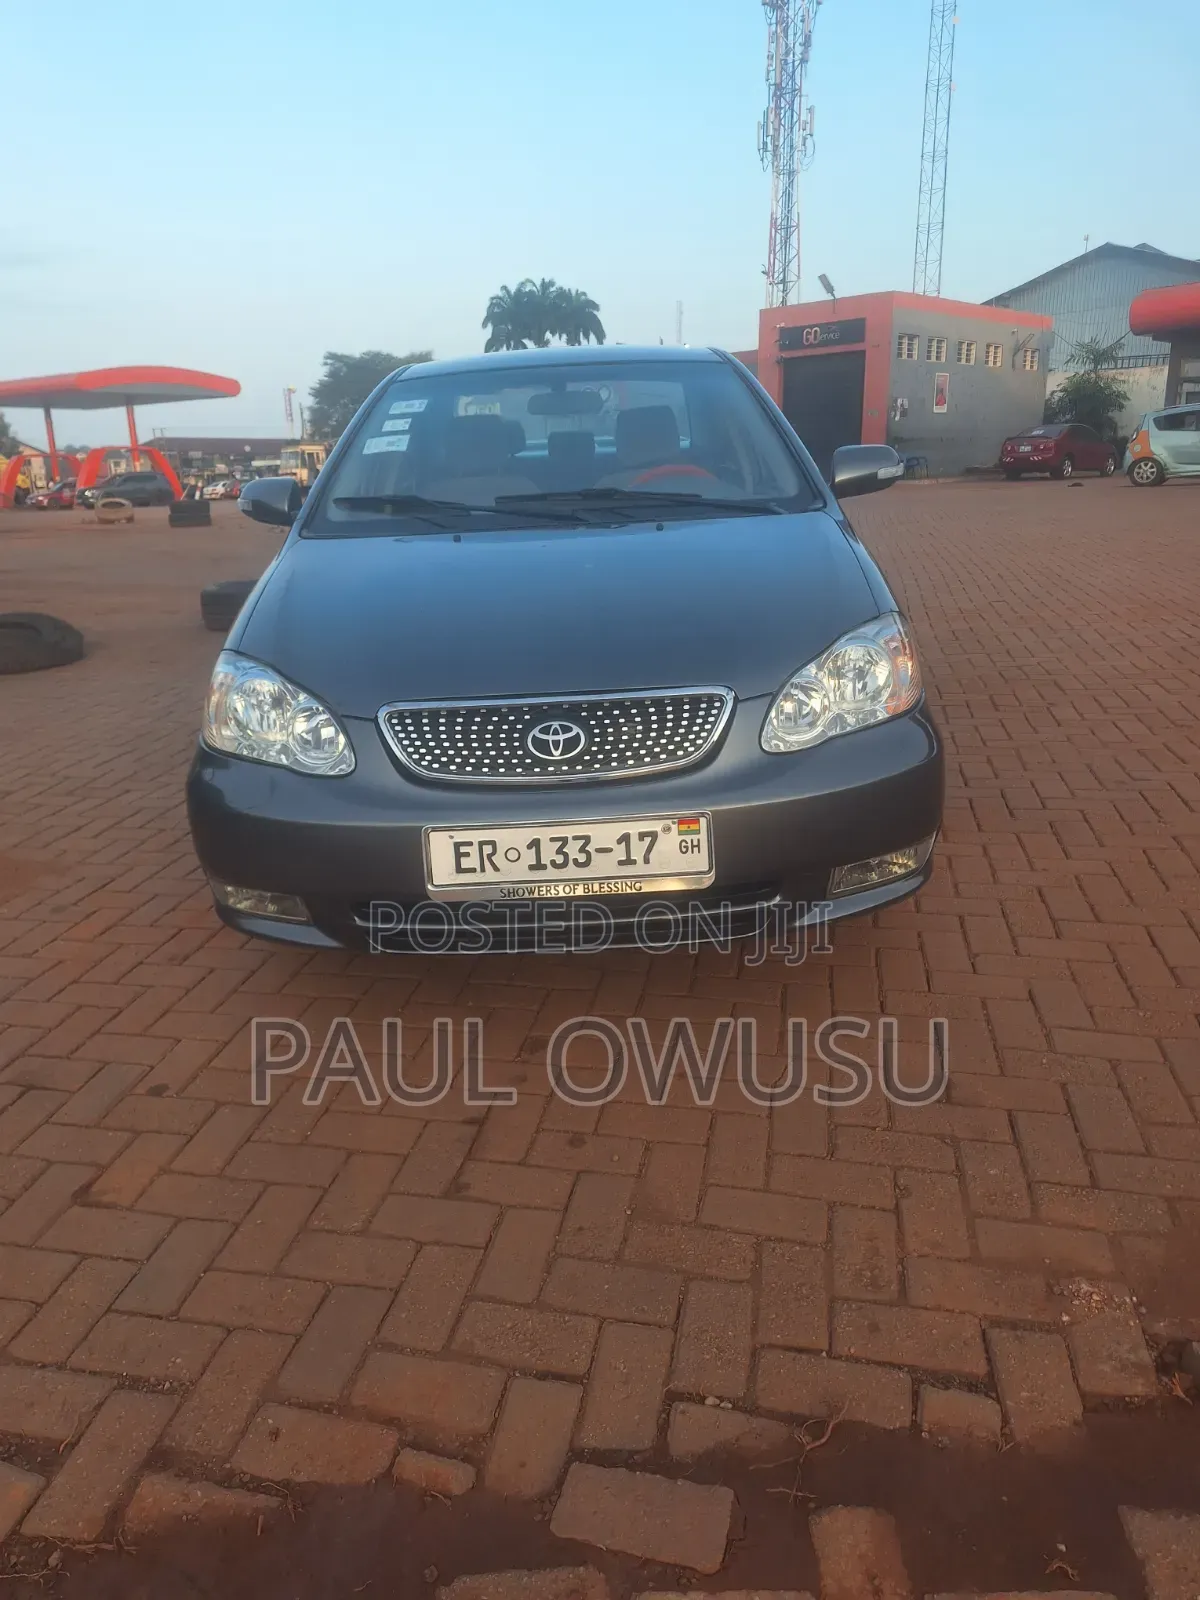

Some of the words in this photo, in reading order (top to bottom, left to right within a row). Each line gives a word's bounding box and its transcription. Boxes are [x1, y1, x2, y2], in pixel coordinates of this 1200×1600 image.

[453, 839, 500, 874] ER
[526, 830, 659, 871] 133-17
[679, 838, 700, 855] GH
[500, 885, 561, 899] SHOWERS
[562, 884, 581, 896] OF
[582, 881, 643, 895] BLESSING
